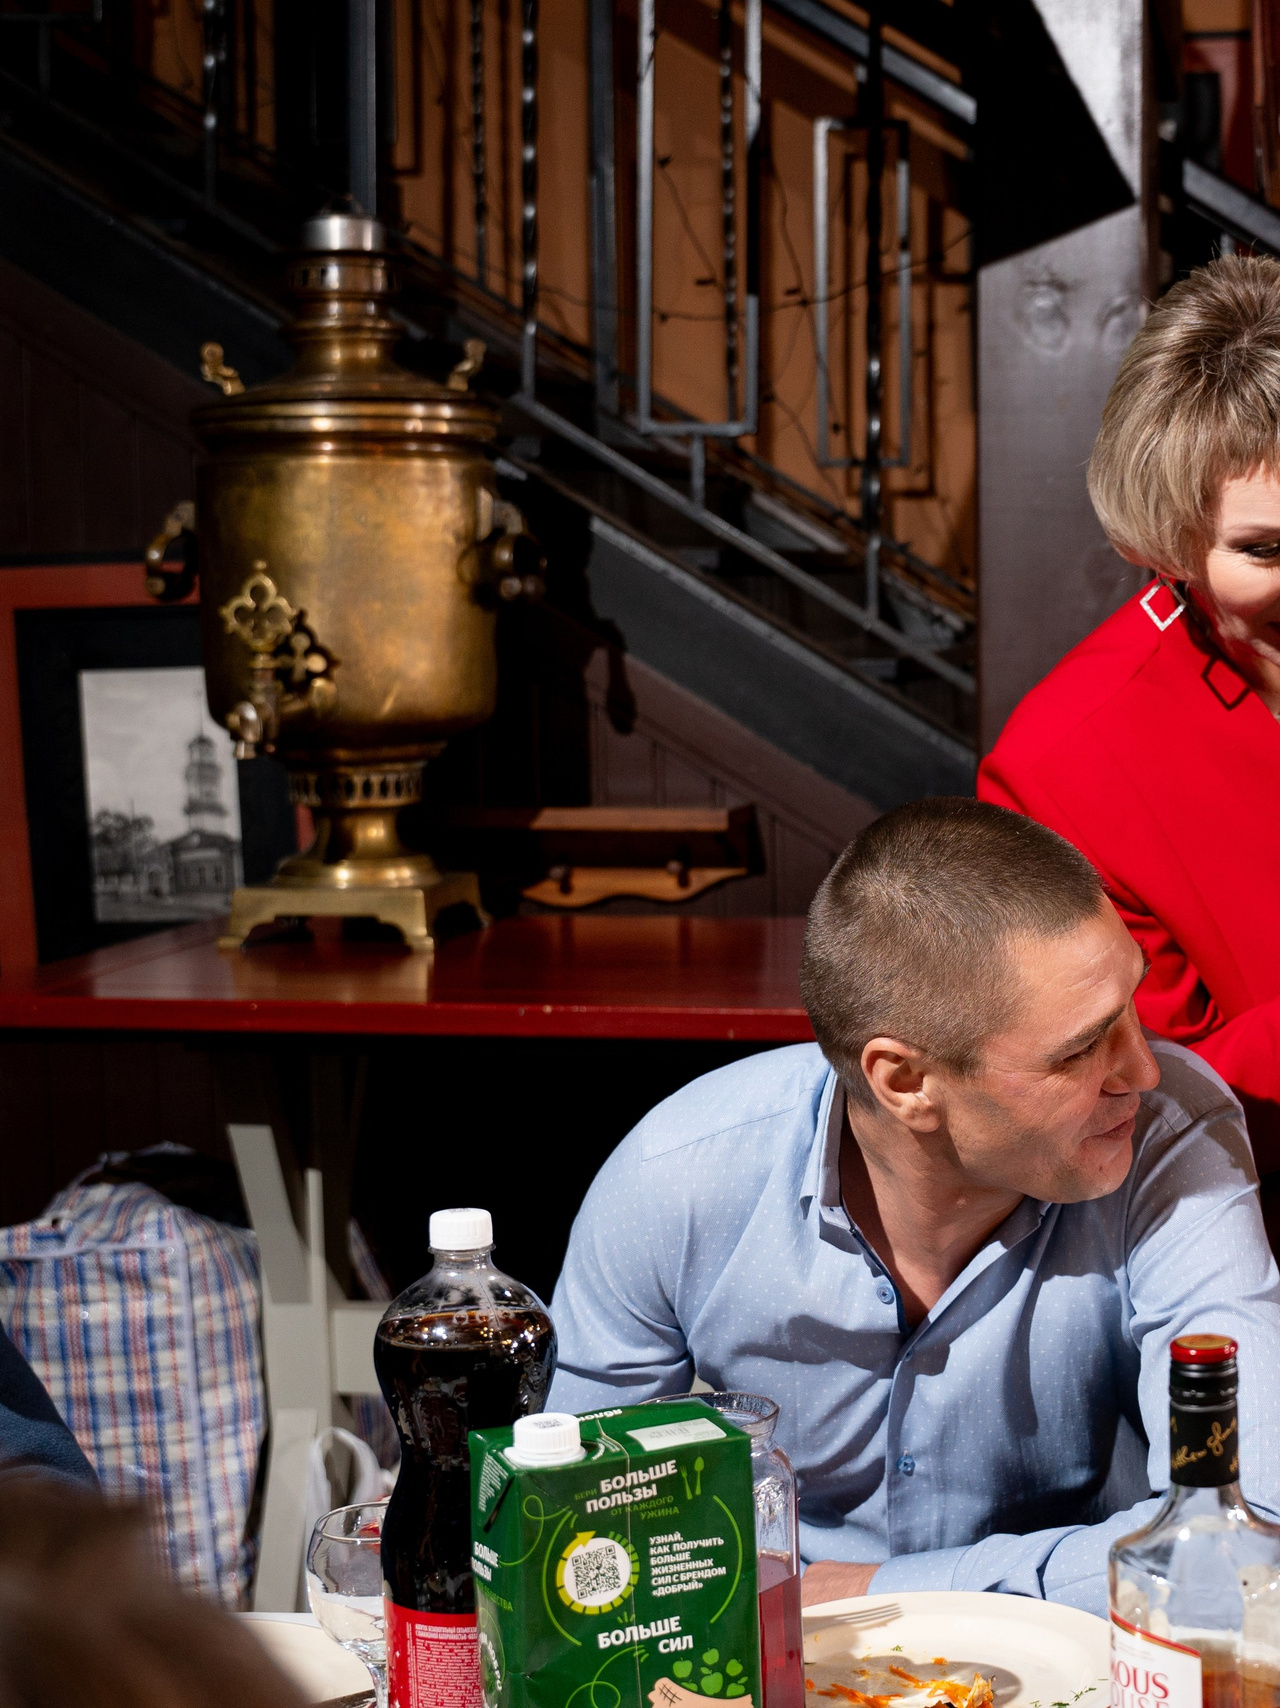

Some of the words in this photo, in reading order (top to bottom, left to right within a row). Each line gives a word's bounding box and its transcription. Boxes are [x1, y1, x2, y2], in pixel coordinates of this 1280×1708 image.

[574, 1488, 598, 1501] БЕРИ
[600, 1460, 678, 1494] БОЛЬШЕ
[586, 1483, 658, 1514] ПОЛЬЗЫ
[610, 1507, 623, 1517] ОТ
[625, 1495, 675, 1514] КАЖДОГО
[640, 1506, 680, 1520] УЖИНА
[649, 1531, 684, 1545] УЗНАЙ,
[650, 1545, 670, 1555] КАК
[672, 1537, 725, 1549] ПОЛУЧИТЬ
[473, 1541, 499, 1568] БОЛЬШЕ
[650, 1551, 691, 1566] БОЛЬШЕ
[651, 1558, 714, 1576] ЖИЗНЕННЫХ
[651, 1575, 672, 1586] СИЛ
[672, 1573, 681, 1583] С
[680, 1566, 727, 1581] БРЕНДОМ
[652, 1580, 704, 1597] «ДОБРЫЙ»
[597, 1615, 682, 1649] БОЛЬШЕ
[658, 1635, 694, 1654] СИЛ
